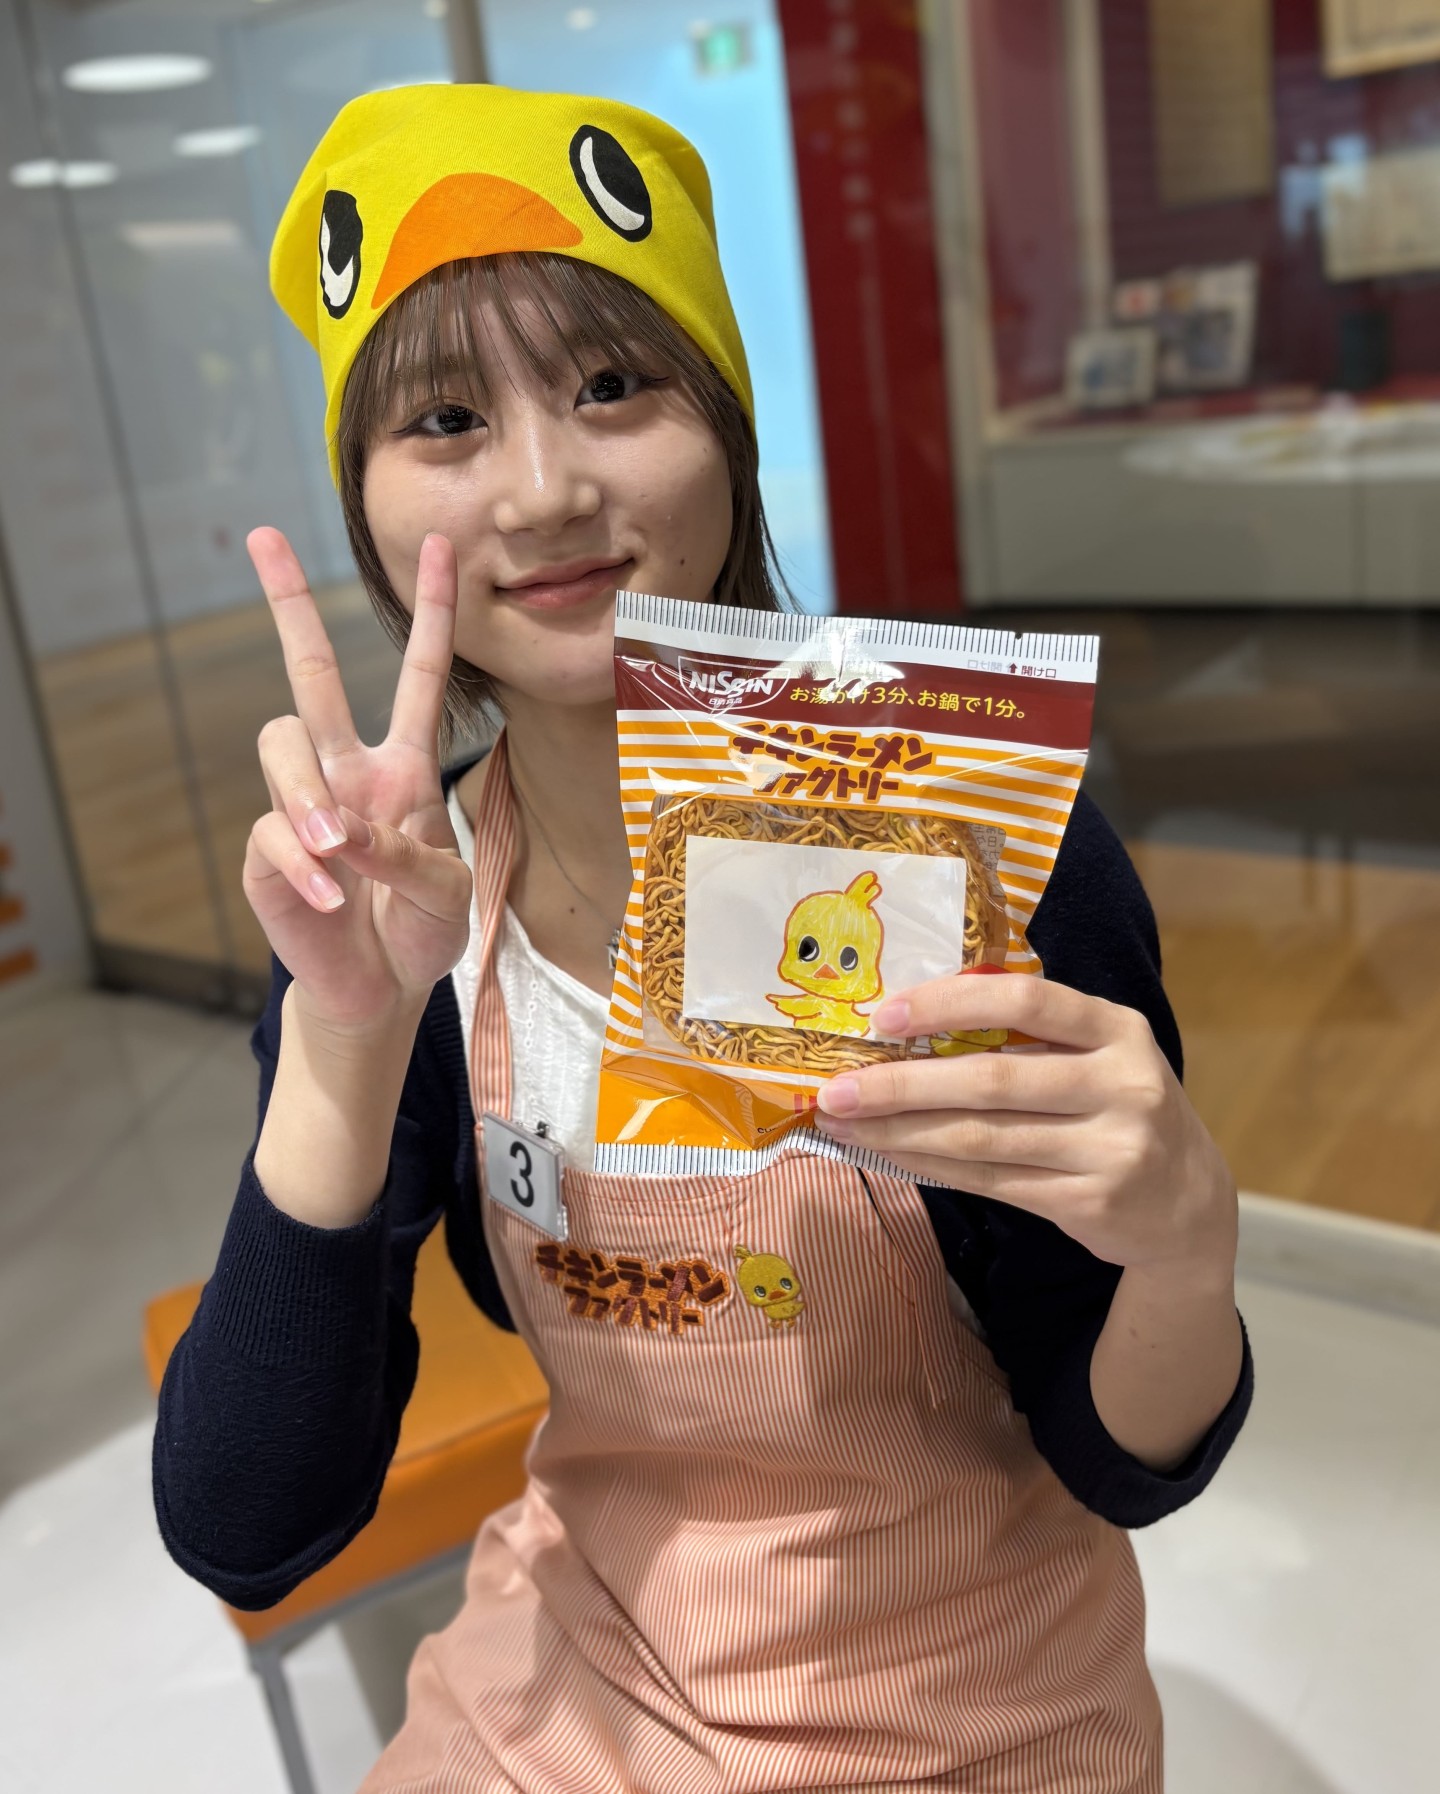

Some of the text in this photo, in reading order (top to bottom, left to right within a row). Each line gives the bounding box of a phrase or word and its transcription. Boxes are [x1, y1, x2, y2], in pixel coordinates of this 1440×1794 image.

[689, 670, 774, 698] NISSIN
[1020, 665, 1057, 679] 開け口
[732, 724, 933, 772] チキンラーメン
[509, 1140, 535, 1208] 3
[535, 1243, 728, 1305] チキンラーメン
[563, 1285, 702, 1335] ファクトリー
